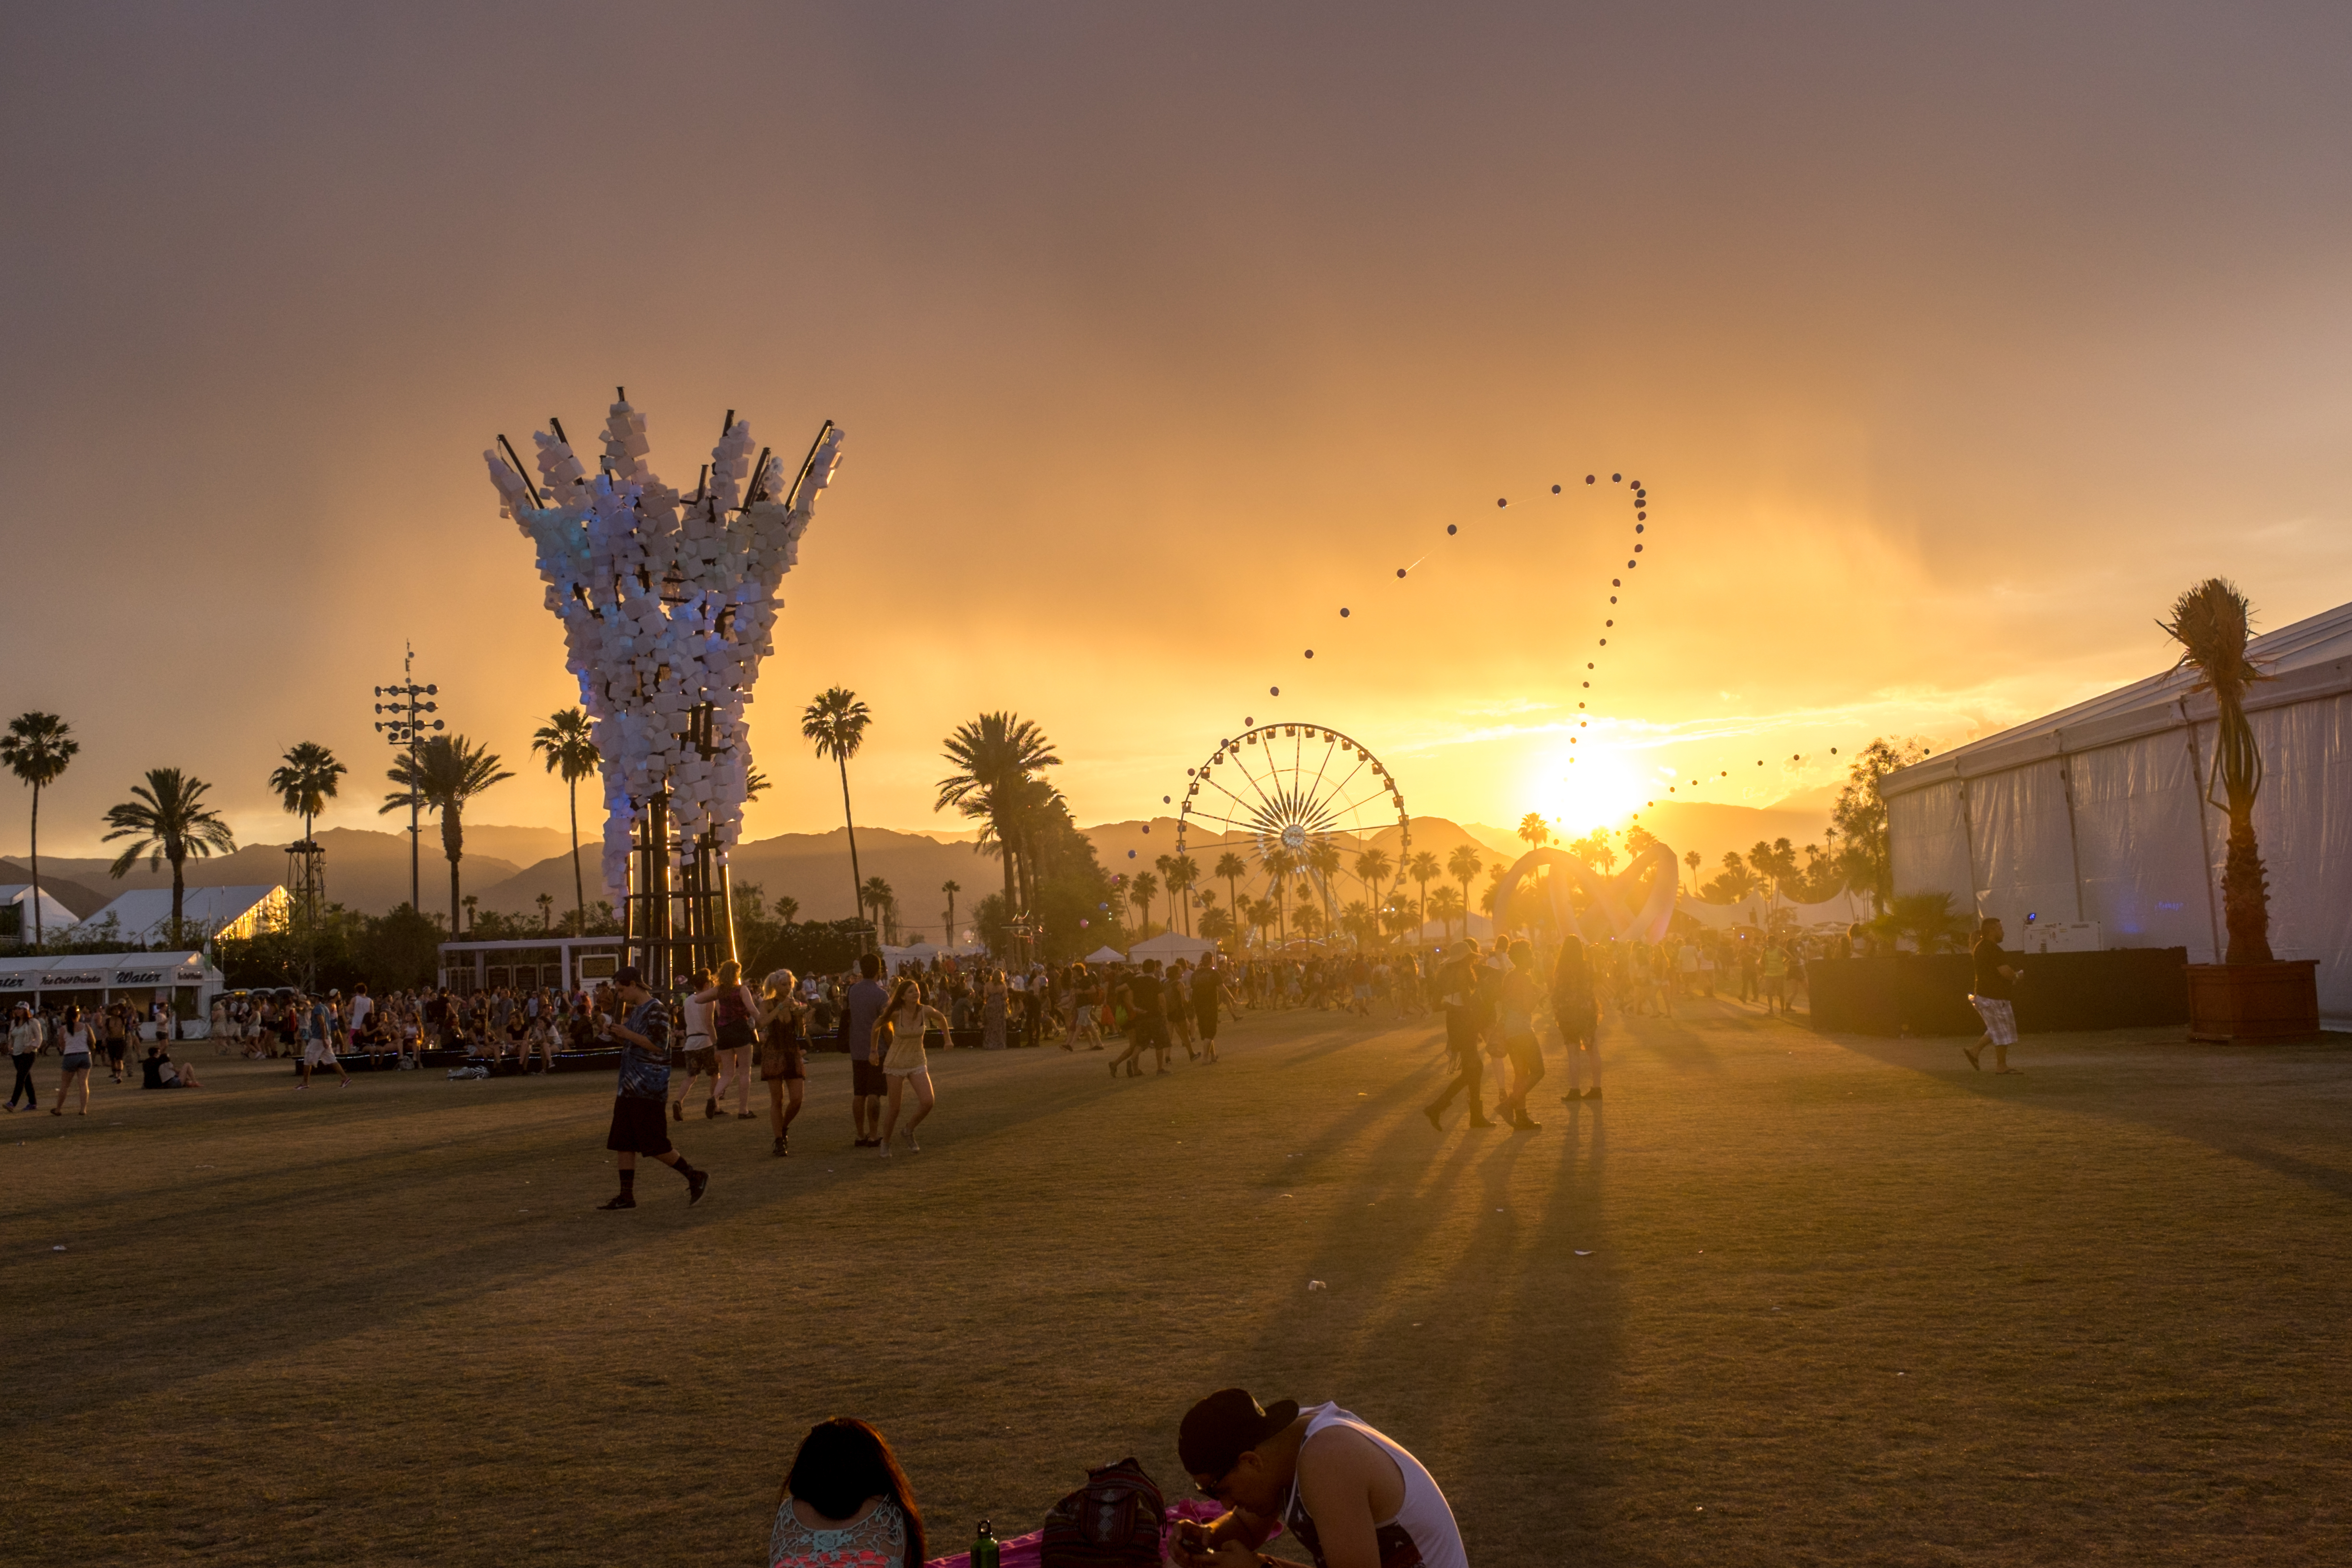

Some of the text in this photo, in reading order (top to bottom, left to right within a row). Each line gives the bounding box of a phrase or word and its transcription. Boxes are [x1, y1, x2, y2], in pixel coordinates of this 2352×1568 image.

[40, 977, 53, 985] Ice
[116, 971, 162, 983] Water
[0, 978, 25, 987] ter
